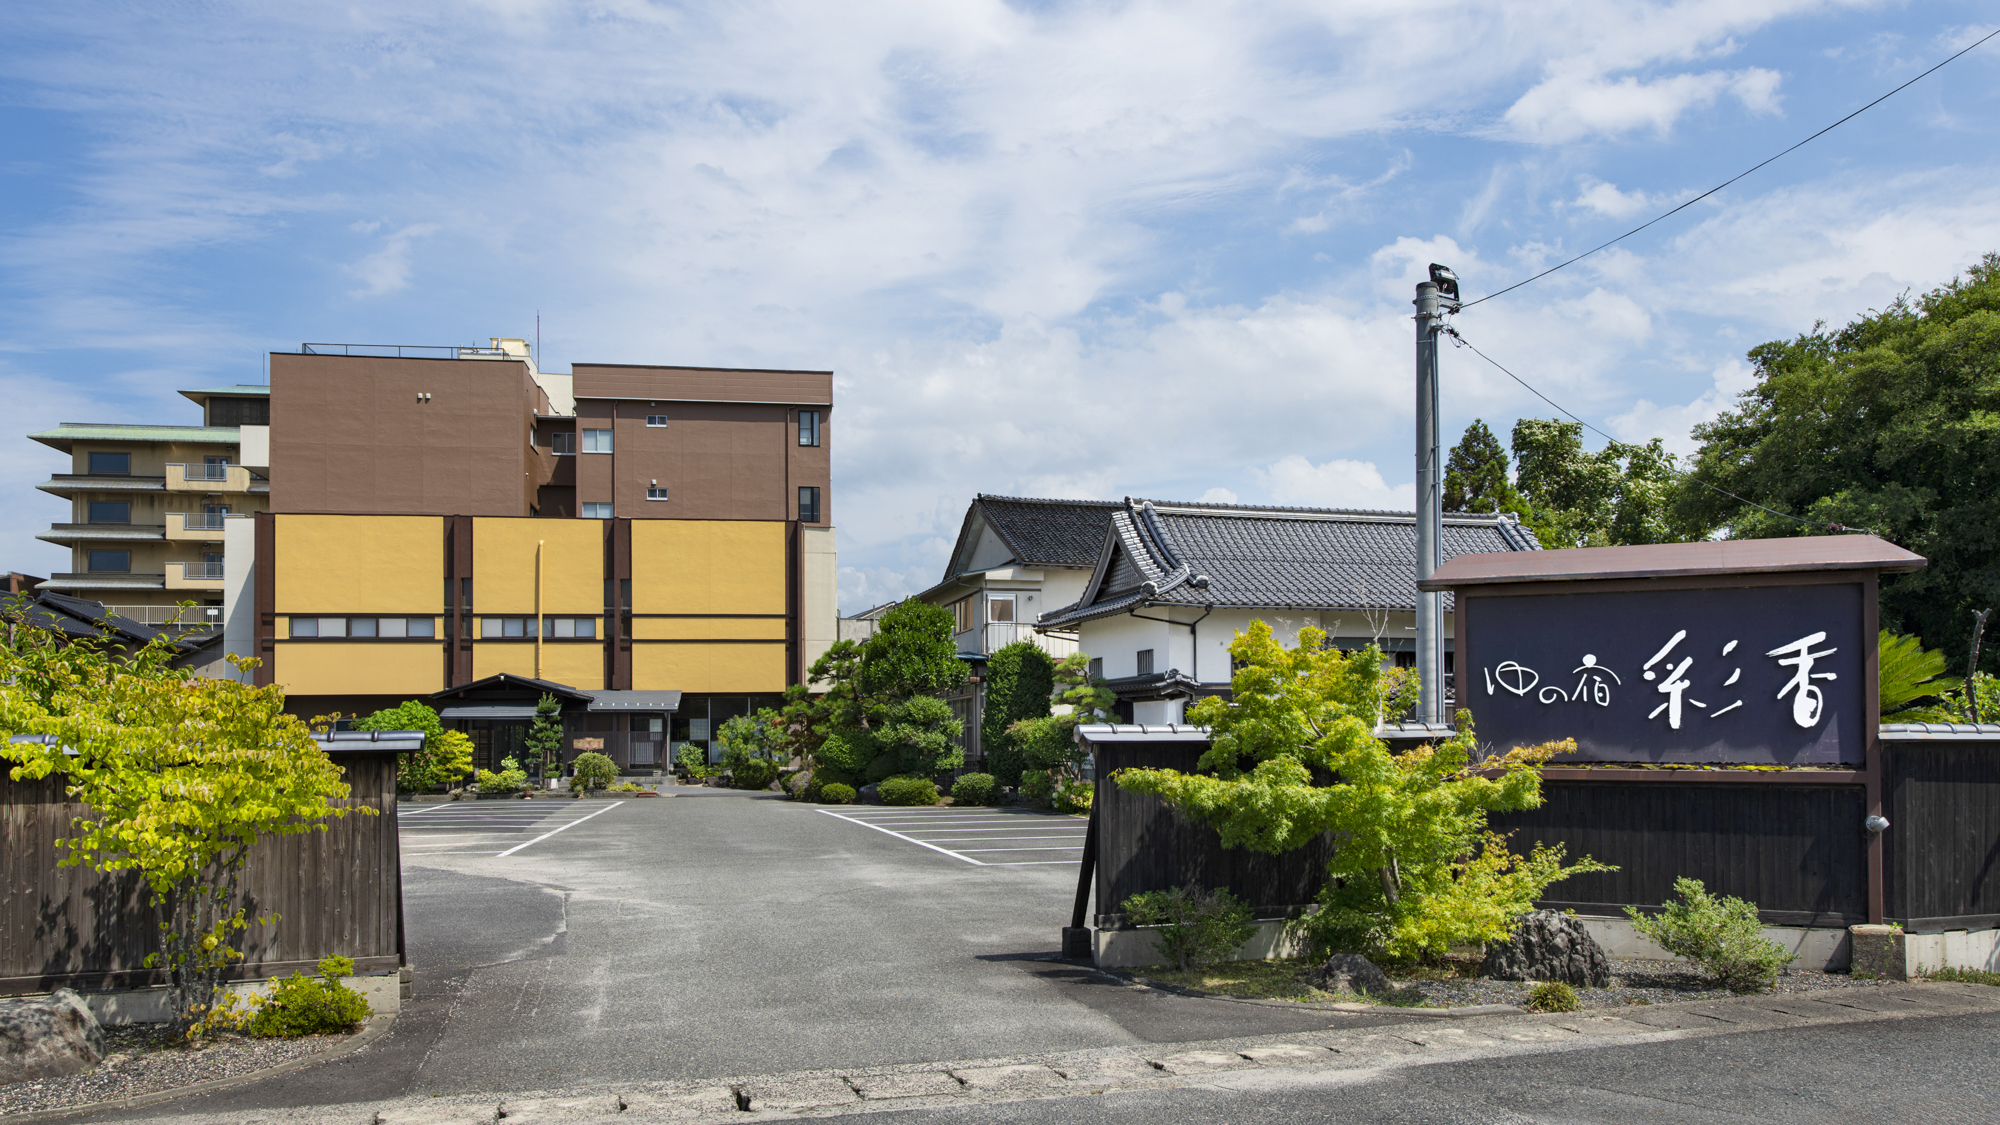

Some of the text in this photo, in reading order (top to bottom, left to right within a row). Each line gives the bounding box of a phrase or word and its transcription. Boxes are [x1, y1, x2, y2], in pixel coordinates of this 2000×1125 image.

[1484, 629, 1838, 730] ゆの宿 彩香
